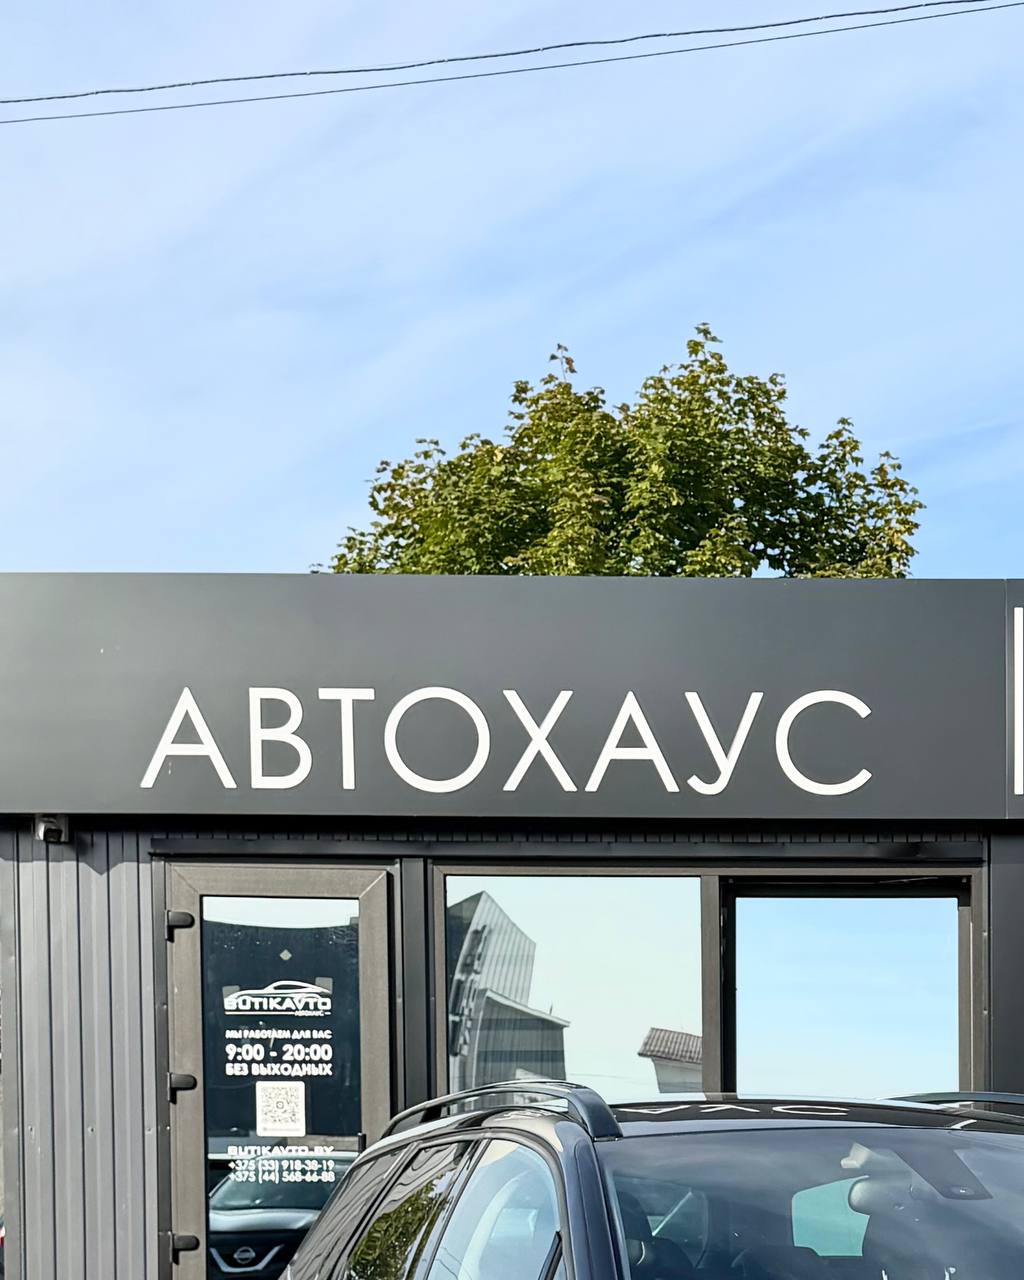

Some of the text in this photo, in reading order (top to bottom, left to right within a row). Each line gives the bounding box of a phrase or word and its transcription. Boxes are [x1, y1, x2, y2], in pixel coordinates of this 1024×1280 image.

[140, 687, 873, 796] АВТОХАУС
[224, 997, 332, 1010] BUTIKAVTO
[225, 1030, 332, 1039] МЫ РАБОТАЕМ ДЛЯ ВАС
[225, 1044, 265, 1060] 9:00
[282, 1044, 333, 1060] 20:00
[225, 1063, 333, 1077] БЕЗ ВЫХОДНЫХ
[227, 1146, 334, 1156] BUTIKAVTO.BY
[228, 1159, 335, 1172] +375 (33) 918-38-19
[228, 1171, 336, 1184] +375 (44) 568-66-88
